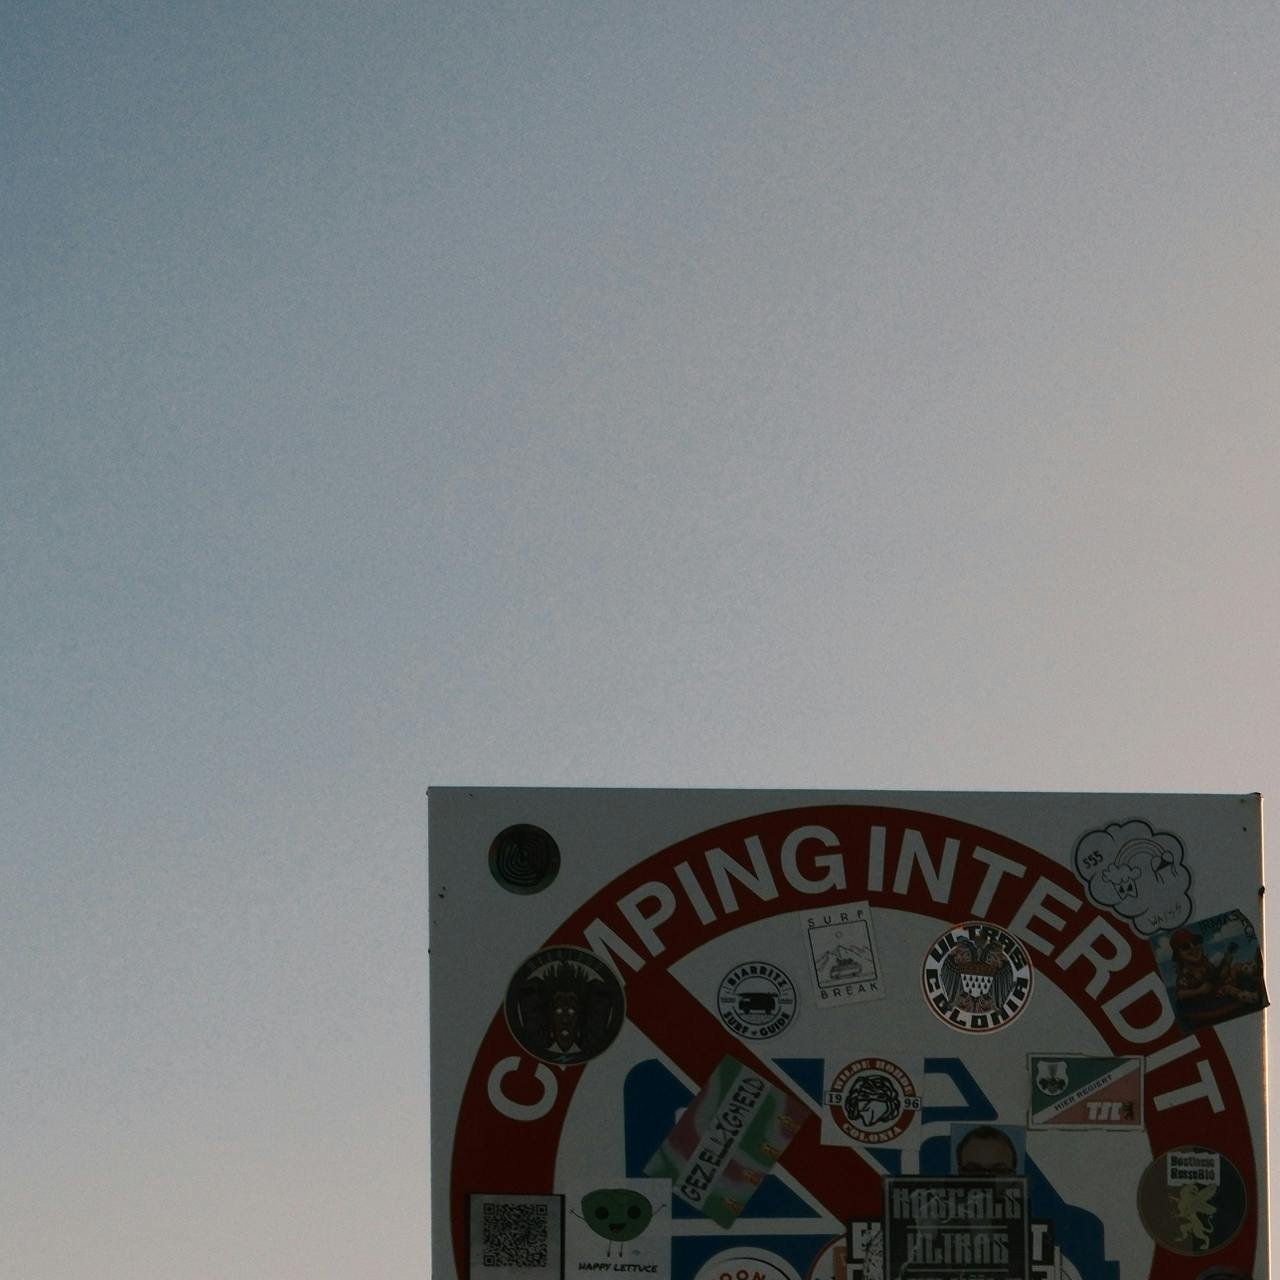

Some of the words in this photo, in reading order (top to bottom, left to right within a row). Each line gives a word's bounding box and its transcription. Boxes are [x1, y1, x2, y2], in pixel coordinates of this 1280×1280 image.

[808, 909, 864, 928] SURF
[930, 923, 1028, 970] ULTRAS
[487, 825, 848, 1122] CMPING
[867, 825, 1226, 1115] INTERDIT
[727, 965, 788, 989] BIARRITZ
[820, 981, 879, 1001] BREAK
[926, 968, 1030, 1030] COLONIA
[724, 1010, 751, 1035] SURF
[759, 1010, 791, 1038] GUIDE
[828, 1093, 843, 1105] 19
[904, 1098, 920, 1110] 96
[578, 1262, 611, 1273] HAPPY
[614, 1262, 658, 1274] LETTUCE
